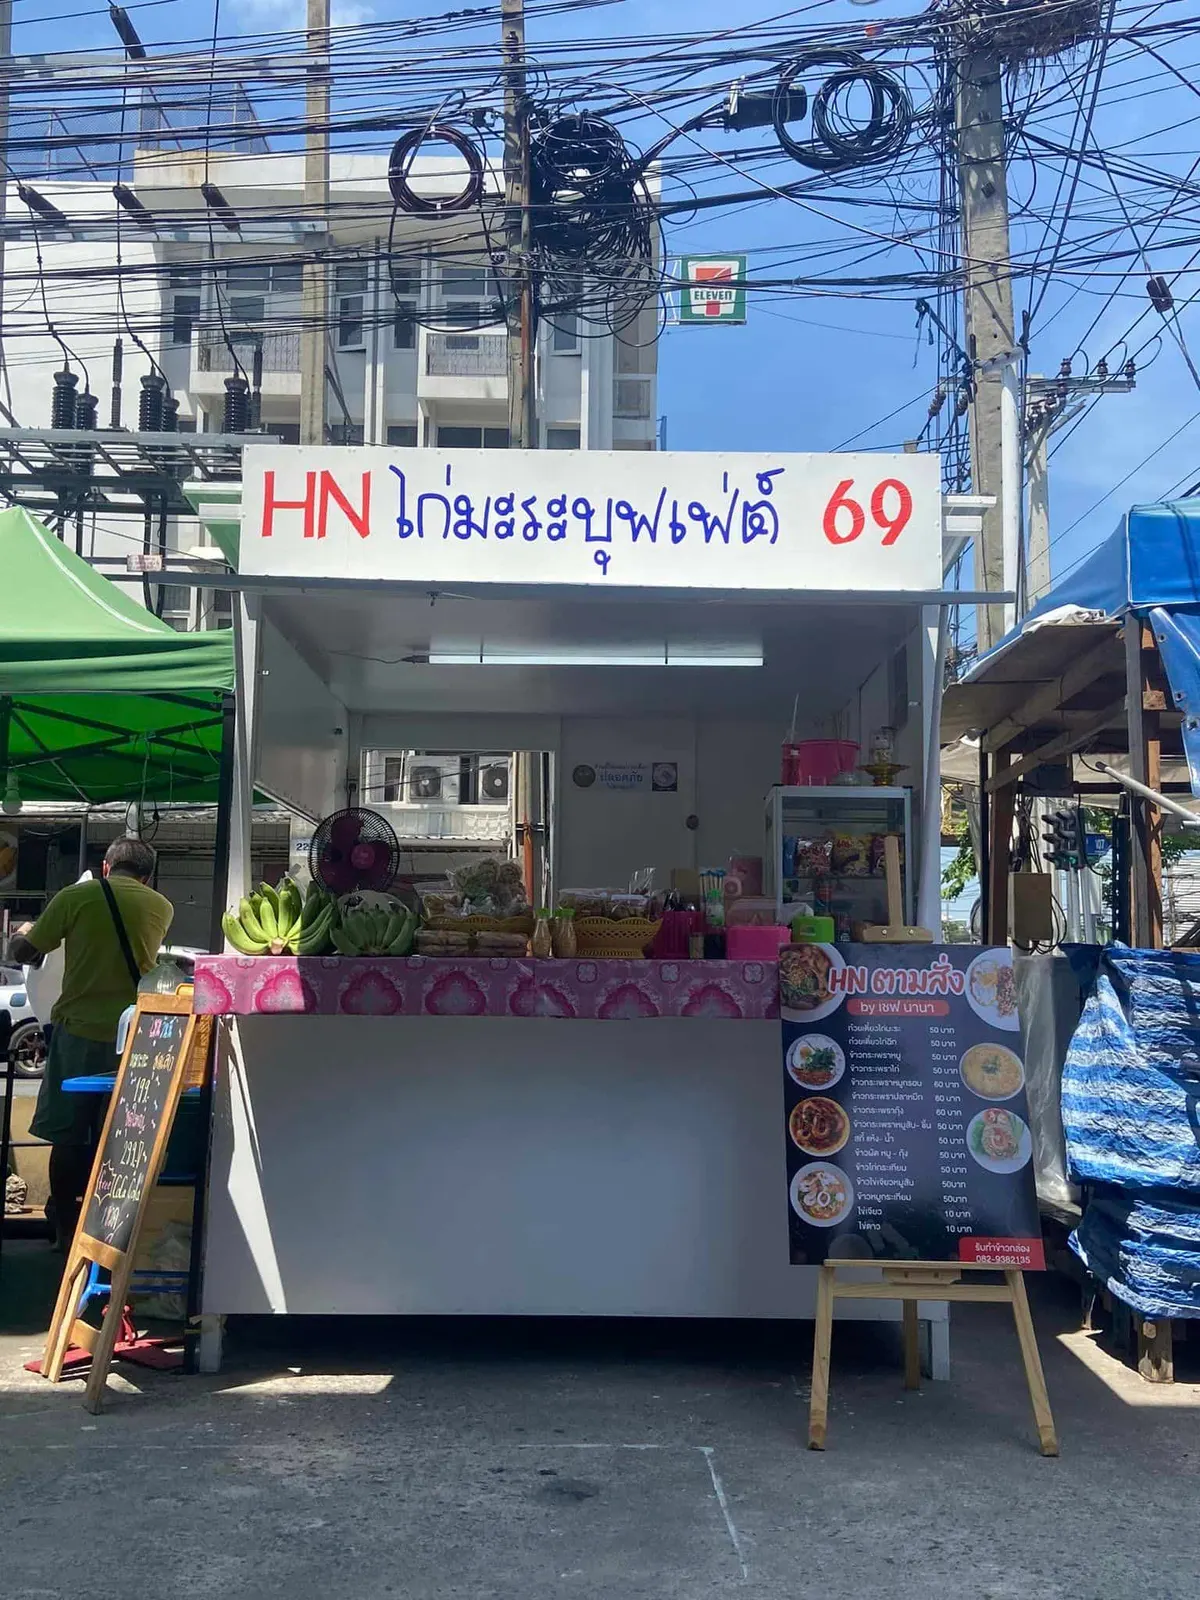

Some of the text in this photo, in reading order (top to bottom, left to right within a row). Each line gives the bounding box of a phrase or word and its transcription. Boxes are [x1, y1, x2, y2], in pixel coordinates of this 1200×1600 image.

[261, 464, 913, 576] HN ไก่มะระบุฟเฟ่ต์ 69
[828, 952, 965, 995] HN ตามสั่ง
[861, 1001, 934, 1015] by เชฟ นานา
